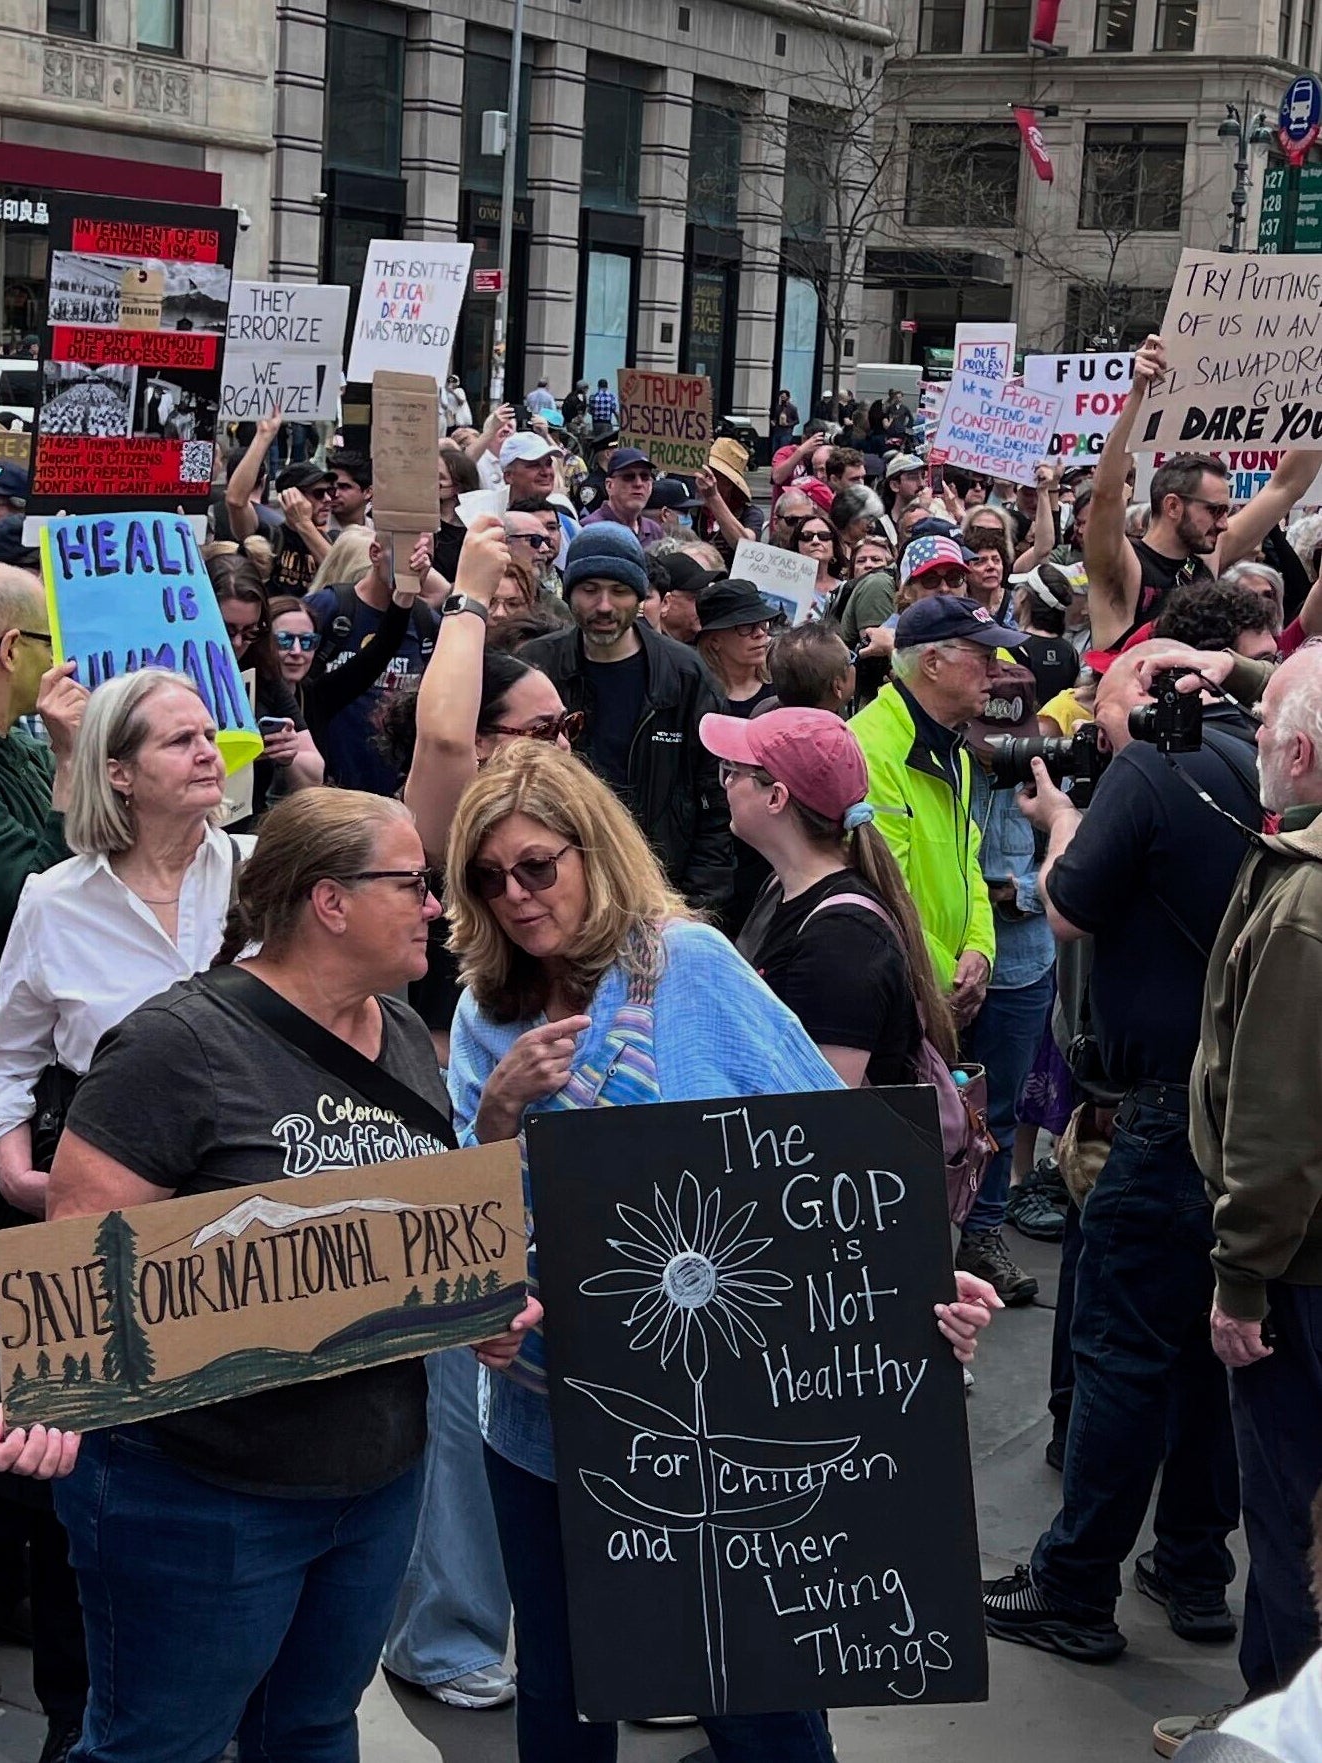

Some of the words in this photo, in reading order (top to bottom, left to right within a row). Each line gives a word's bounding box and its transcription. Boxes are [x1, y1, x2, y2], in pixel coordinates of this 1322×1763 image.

[76, 218, 173, 241] INTERNMENT
[174, 230, 195, 244] OF
[198, 230, 217, 246] US
[96, 236, 162, 256] CITIZENS
[166, 243, 197, 259] 1942
[373, 260, 405, 278] THIS
[1183, 262, 1231, 301] TRY
[250, 289, 297, 312] THEY
[693, 299, 720, 315] ETAIL
[228, 315, 323, 343] ERRORIZE
[692, 317, 720, 333] PACE
[1178, 311, 1212, 337] OF
[1219, 314, 1242, 337] US
[1256, 315, 1281, 338] IN
[1287, 313, 1321, 339] AN
[67, 344, 96, 360] DUE
[102, 347, 170, 364] PROCESS
[172, 351, 205, 366] 2025
[74, 330, 136, 347] DEPORT
[140, 334, 205, 352] WITHOUT
[974, 347, 997, 359] DUE
[252, 362, 282, 385] WE
[222, 365, 326, 417] RGANIZE!
[639, 375, 703, 408] TRUMP
[1076, 393, 1129, 416] FOX
[620, 404, 707, 440] DESERVES
[1142, 409, 1164, 442] I
[1179, 405, 1271, 443] DARE
[87, 453, 103, 464] US
[649, 441, 706, 469] PROCESS
[948, 445, 1027, 478] DOMESTIC
[35, 466, 90, 479] HISTORY
[72, 481, 97, 493] SAY
[103, 481, 114, 493] IT
[118, 481, 151, 494] CANT
[57, 519, 206, 580] HEALT
[163, 585, 199, 623] IS
[317, 1094, 404, 1125] Colora
[703, 1107, 815, 1173] The
[782, 1170, 906, 1232] G.O.P.
[829, 1239, 863, 1262] is
[2, 1258, 117, 1349] SAVE
[138, 1253, 206, 1325] OUR
[208, 1218, 390, 1312] NATIONAL
[397, 1201, 508, 1277] PARKS
[807, 1266, 898, 1333] Not
[762, 1342, 928, 1414] Healthy
[608, 1527, 677, 1563] and
[763, 1567, 916, 1637] Living
[794, 1622, 953, 1699] Things
